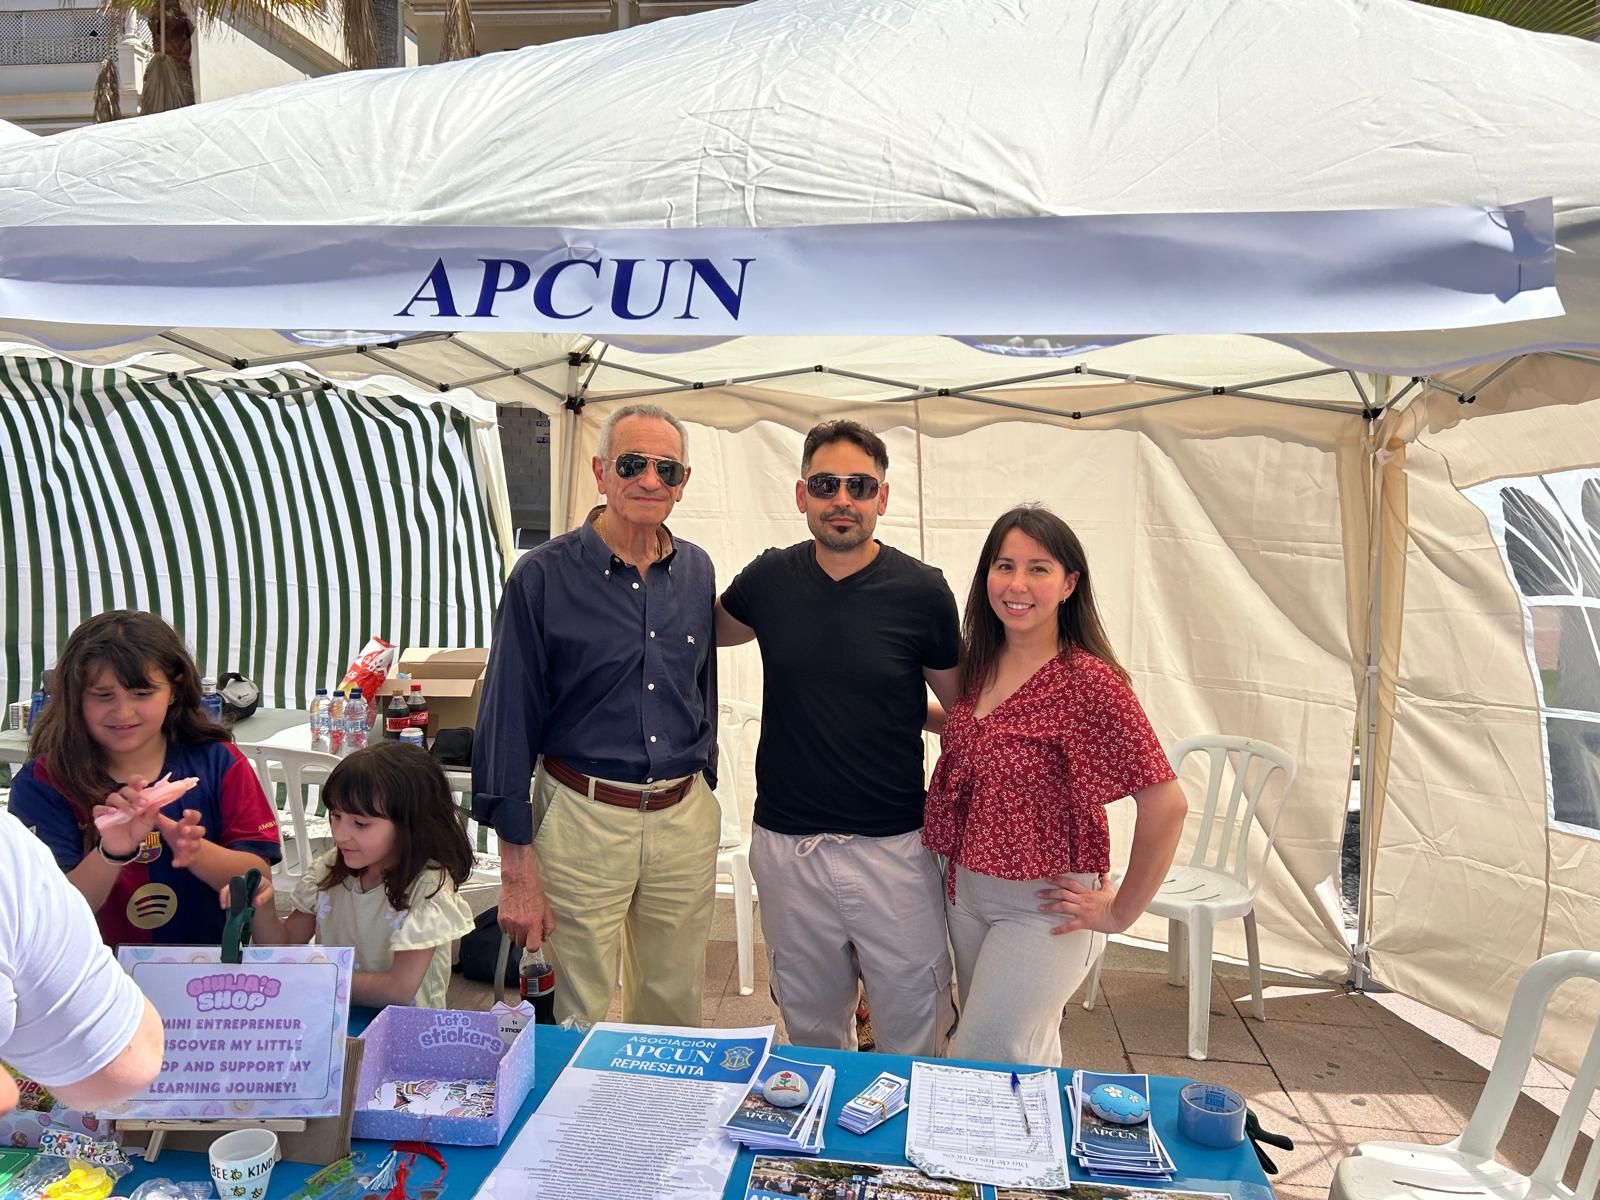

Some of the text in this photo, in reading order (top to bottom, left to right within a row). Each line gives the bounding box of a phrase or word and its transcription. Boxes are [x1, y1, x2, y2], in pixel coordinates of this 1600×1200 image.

[393, 257, 756, 320] APCUN
[186, 973, 282, 998] GIULIA'S
[196, 990, 267, 1012] SHOP
[162, 1018, 301, 1030] MINI ENTREPRENEUR
[435, 1013, 471, 1028] Let's
[164, 1039, 303, 1051] ISCOVER MY LITTLE
[420, 1026, 503, 1054] stickers
[628, 1035, 717, 1049] ASOCIACIÓN
[615, 1043, 714, 1064] APCUN
[183, 1061, 215, 1073] AND
[219, 1061, 284, 1073] SUPPORT
[289, 1061, 312, 1073] MY
[610, 1057, 704, 1077] REPRESENTA
[149, 1082, 297, 1094] LEARNING JOURNEY!
[741, 1111, 787, 1123] APCUN
[1090, 1127, 1138, 1140] APCUN
[211, 1157, 274, 1181] BEE KIND
